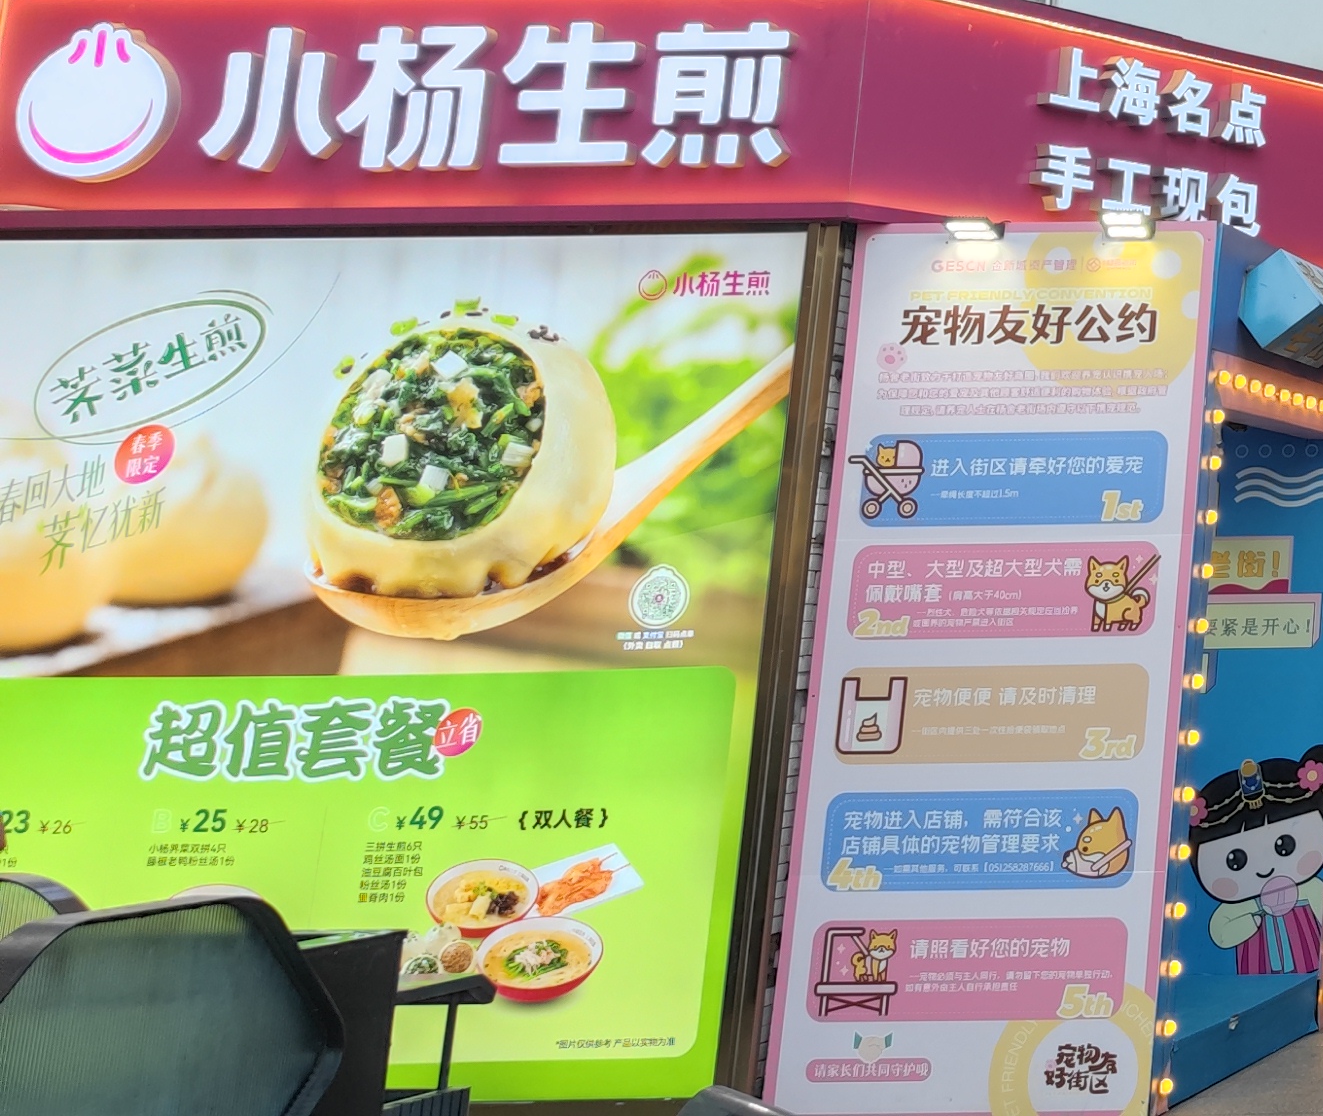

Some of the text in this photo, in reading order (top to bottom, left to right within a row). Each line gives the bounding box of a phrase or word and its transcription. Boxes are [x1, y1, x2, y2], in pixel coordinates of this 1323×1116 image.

[199, 22, 793, 171] 小杨生煎
[1044, 47, 1267, 148] 上海名点
[1038, 144, 1262, 237] 手工现包
[931, 259, 986, 273] GESCN
[673, 270, 771, 297] 小杨生煎
[910, 287, 1153, 302] PET FRIENDLY CONVENTION
[900, 304, 1158, 345] 宠物友好公约
[50, 313, 249, 425] 荠菜生煎
[131, 431, 163, 455] 春季
[126, 456, 160, 478] 限定
[930, 455, 1143, 478] 进入街区请牵好您的爱宠
[0, 453, 106, 526] 春回大地
[1102, 491, 1143, 521] 1st
[39, 486, 167, 576] 荠忆犹新
[867, 558, 1083, 580] 中型、大型及超大型犬需
[866, 584, 943, 604] 佩戴嘴套
[854, 608, 910, 637] 2nd
[913, 686, 1097, 707] 宠物便便 请及时清理
[140, 696, 448, 780] 超值套餐
[436, 713, 481, 748] 立省
[1079, 727, 1138, 760] 3rd
[180, 808, 227, 833] ¥25
[396, 805, 444, 830] ¥49
[841, 833, 1060, 856] 店铺具体的宠物管理要求
[827, 857, 882, 890] 4th
[909, 937, 1071, 960] 请照看好您的宠物
[1056, 984, 1113, 1019] 5th
[814, 1062, 929, 1078] 请家长们共同守护哦
